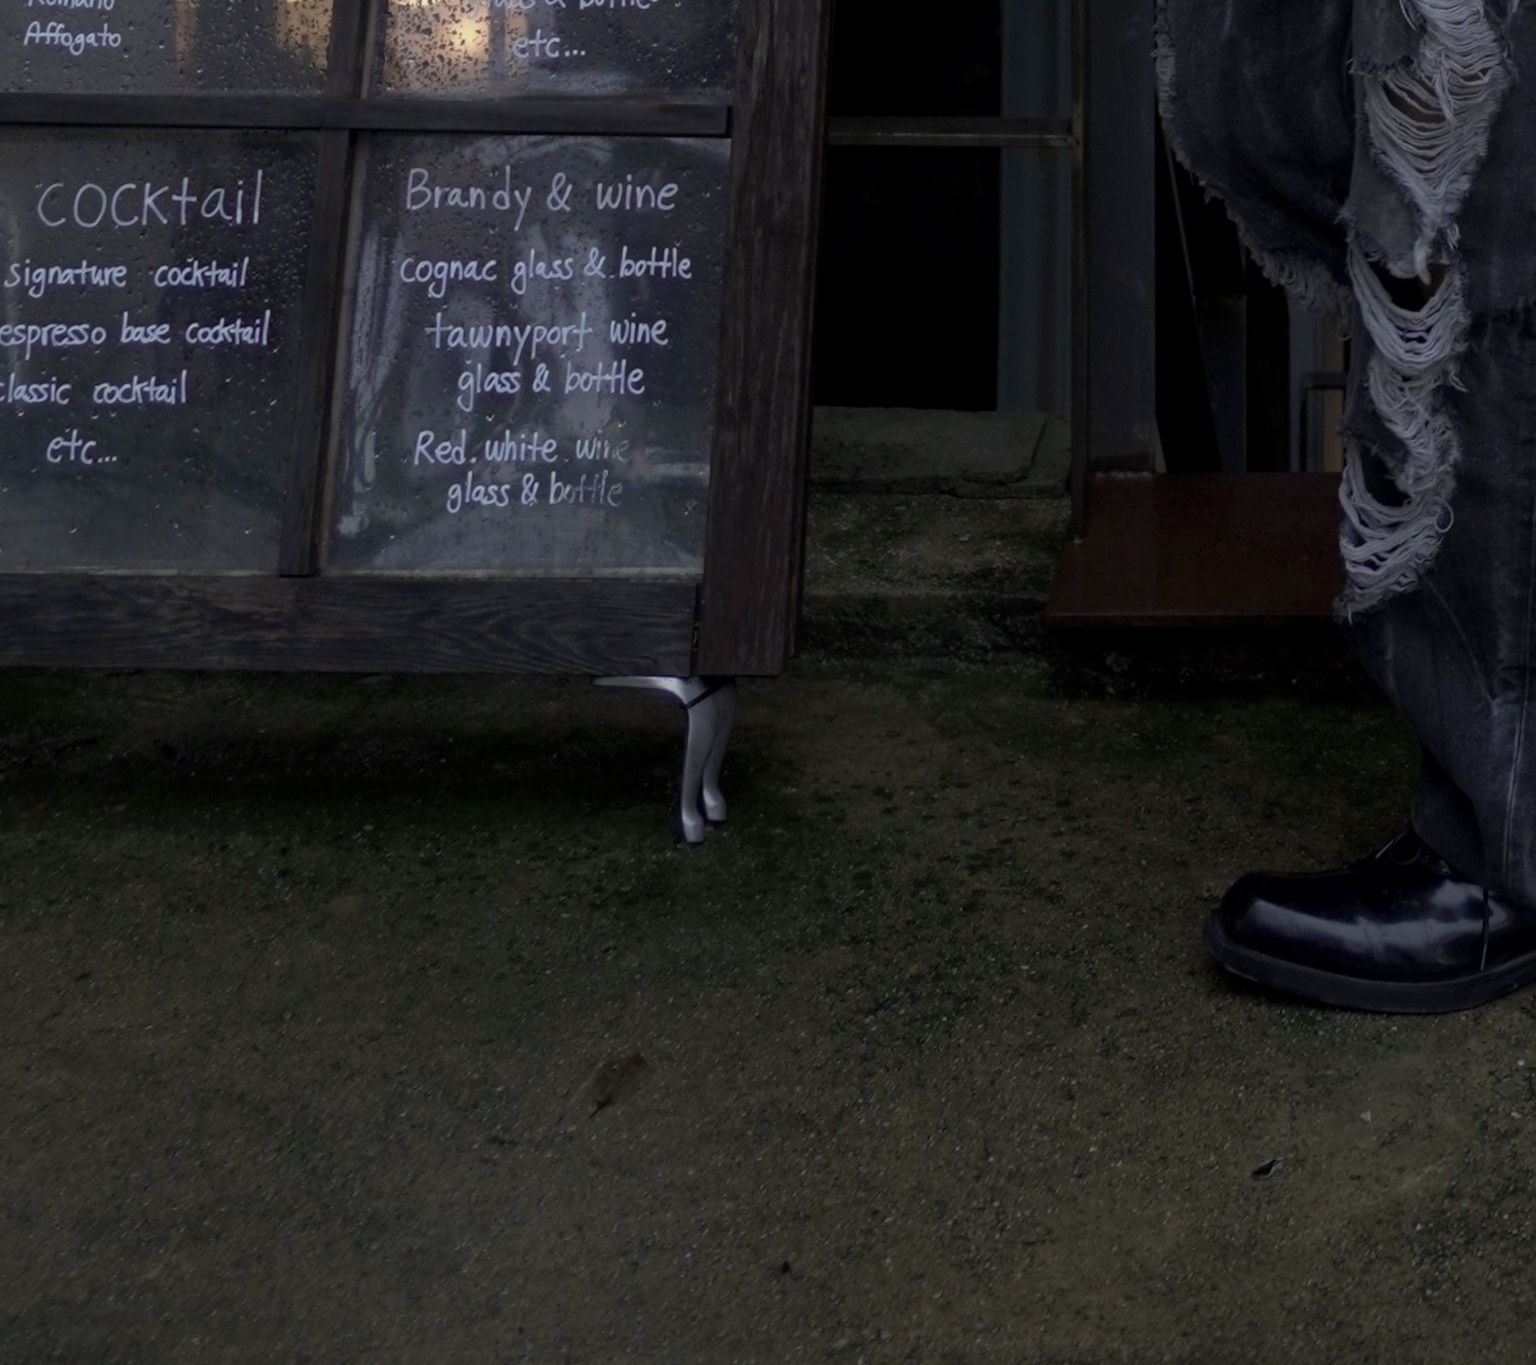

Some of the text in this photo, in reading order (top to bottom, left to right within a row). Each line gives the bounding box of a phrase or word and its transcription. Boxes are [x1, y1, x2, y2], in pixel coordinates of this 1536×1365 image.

[23, 20, 122, 55] Affogato
[405, 165, 679, 231] Brandy & wine
[4, 256, 250, 298] signature cocktail
[400, 246, 693, 298] cognac glass & bottle
[0, 308, 272, 361] espresso base cocktail
[425, 312, 669, 366] tawnyport wine
[93, 369, 188, 405] cocktail
[457, 358, 646, 412] glass & bottle
[485, 429, 558, 463] white
[575, 428, 630, 463] wine
[446, 469, 624, 514] glass & bottle
